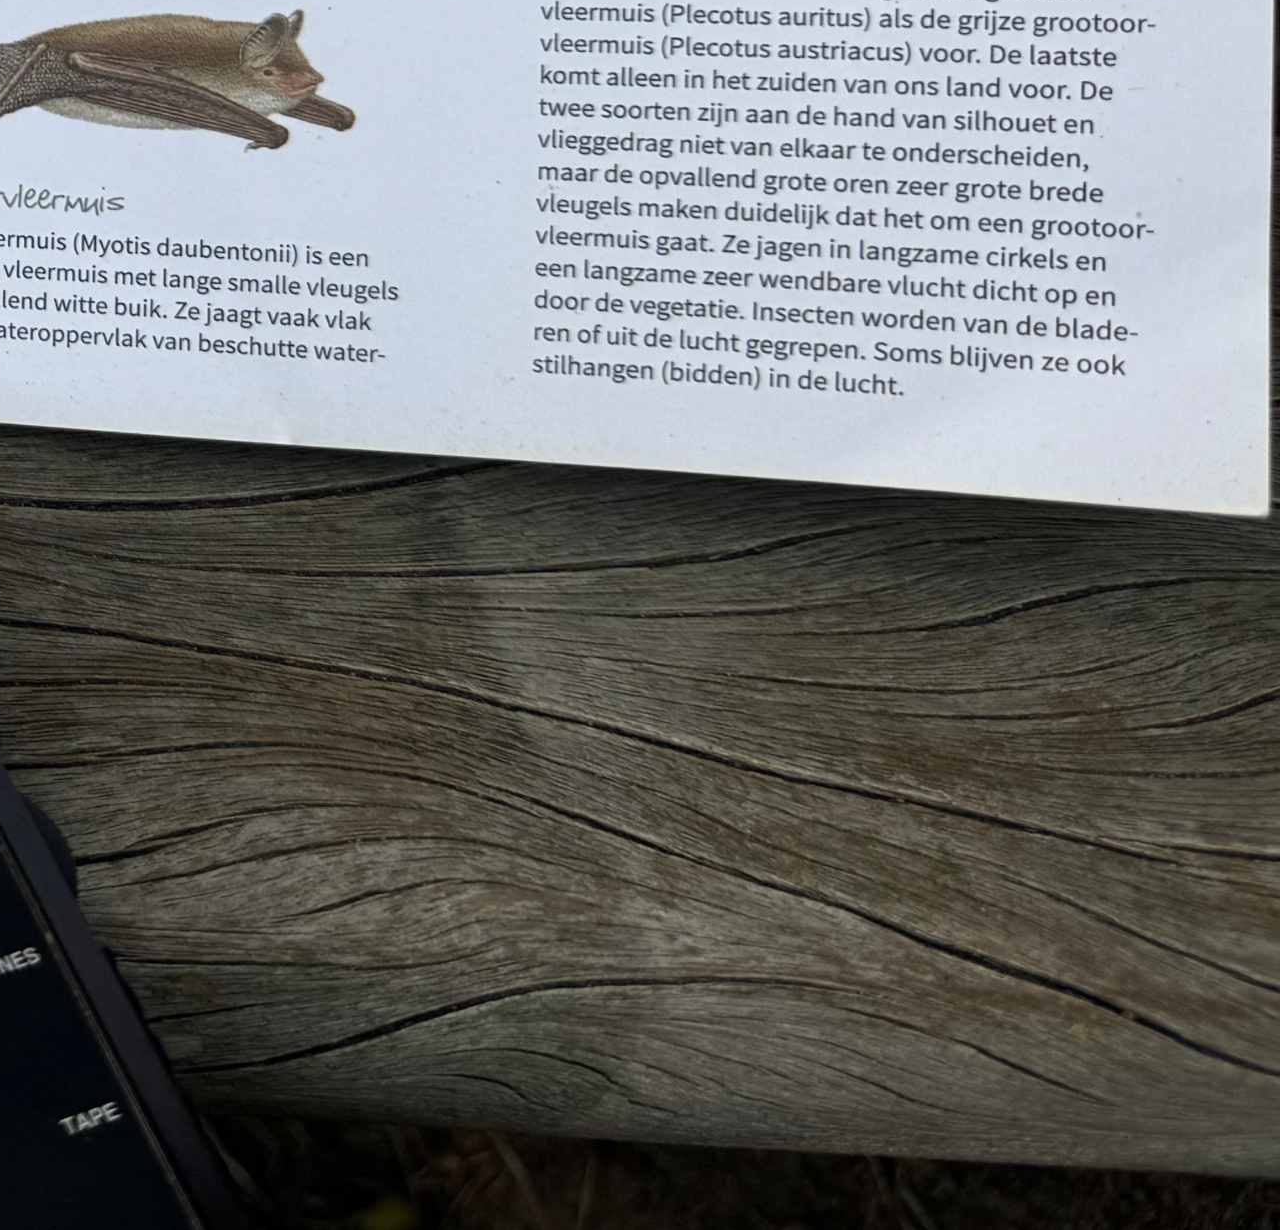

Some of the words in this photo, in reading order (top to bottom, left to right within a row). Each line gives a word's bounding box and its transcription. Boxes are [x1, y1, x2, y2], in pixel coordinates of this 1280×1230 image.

[74, 233, 150, 257] (Myotis
[157, 237, 298, 267] daubentonii)
[307, 246, 322, 265] is
[329, 252, 368, 267] een
[533, 355, 654, 383] stilhangen
[662, 361, 760, 390] (bidden)
[770, 368, 790, 388] in
[798, 370, 827, 391] de
[835, 371, 904, 396] lucht.
[59, 1102, 122, 1134] TAPE
